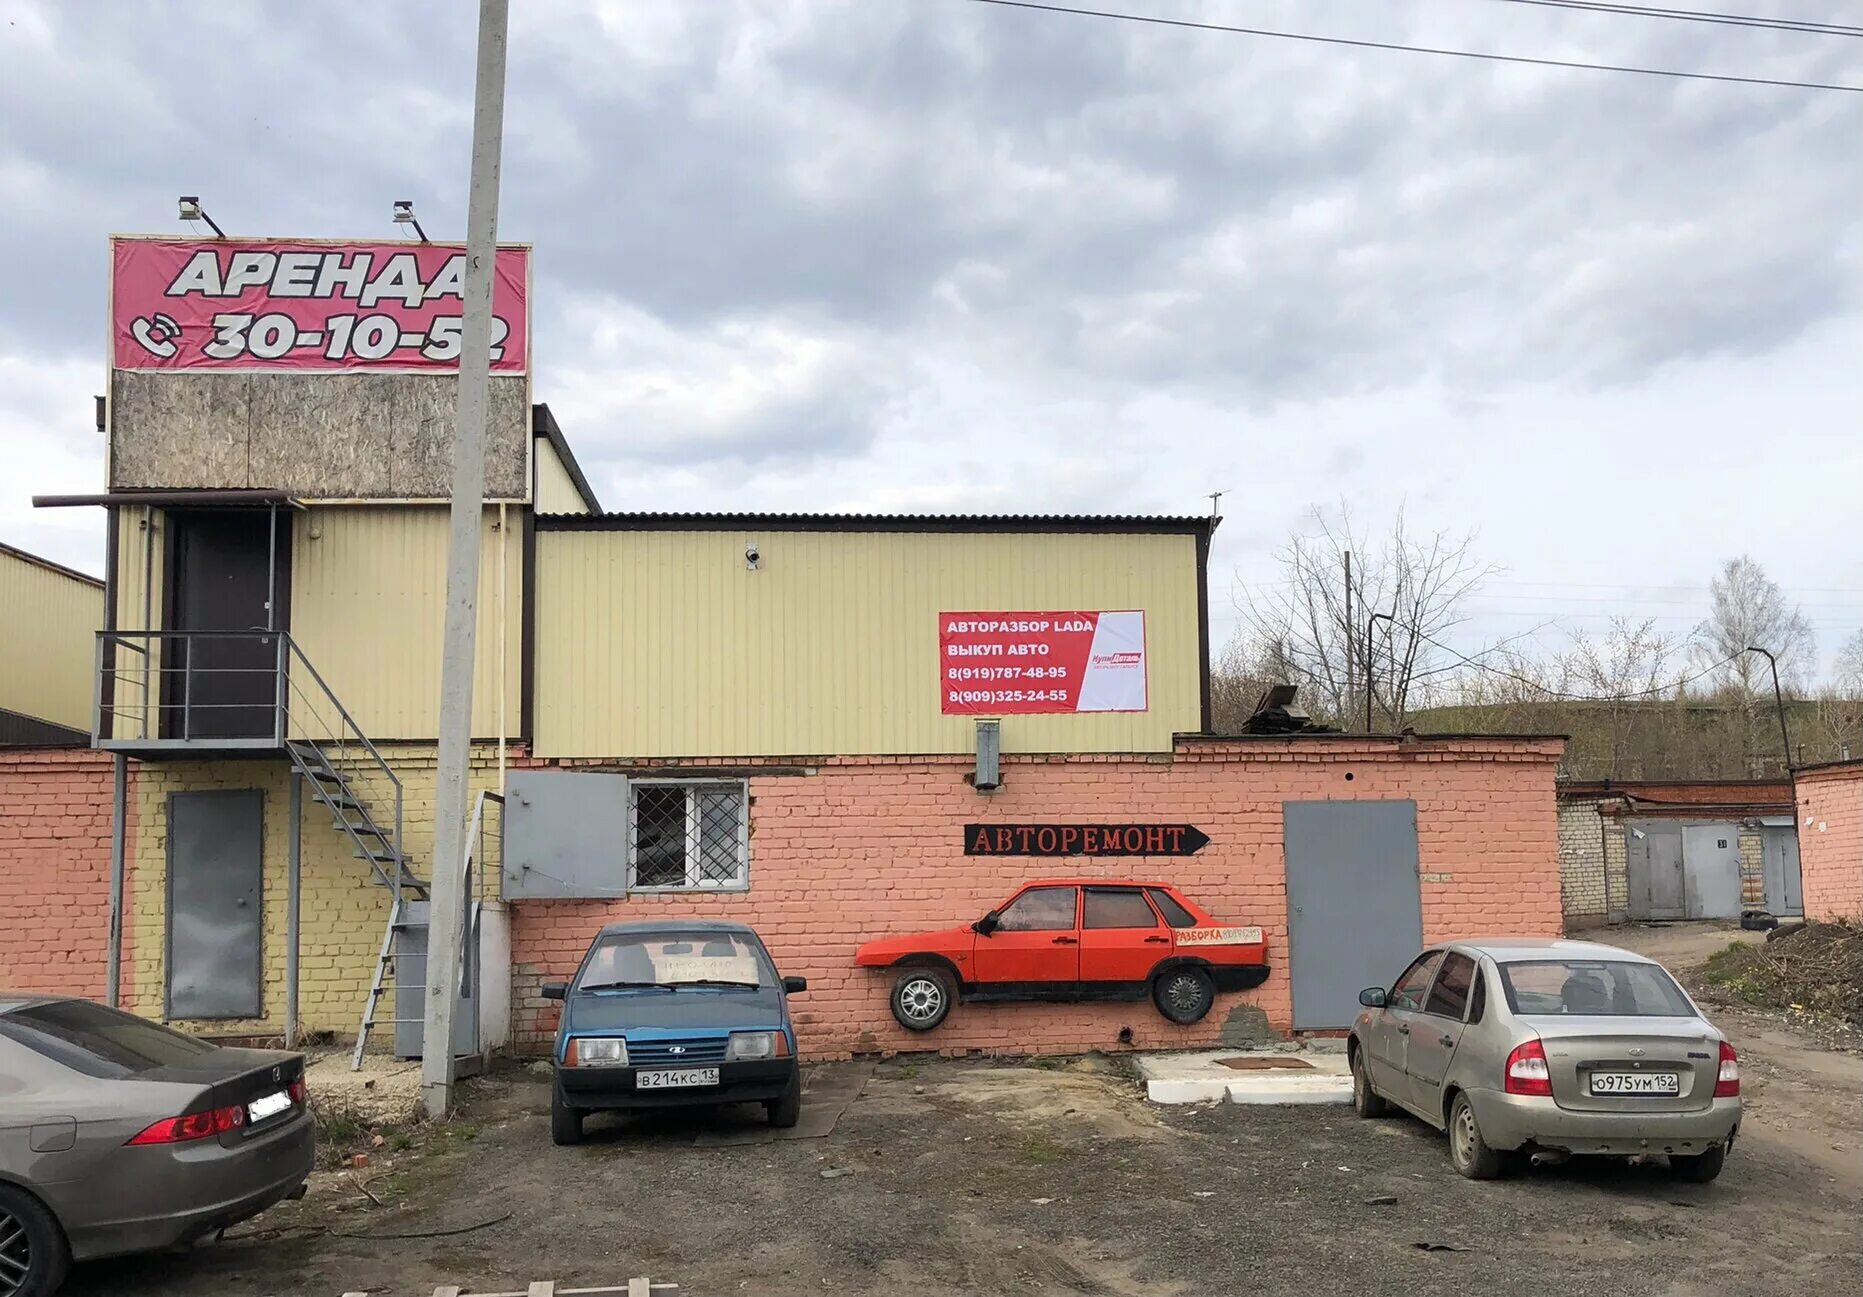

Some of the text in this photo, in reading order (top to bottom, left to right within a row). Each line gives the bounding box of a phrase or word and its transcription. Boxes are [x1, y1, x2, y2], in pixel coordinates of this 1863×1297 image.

[164, 250, 468, 308] АРЕНДА
[947, 620, 1094, 633] АВТОРАЗБОР LADA
[948, 644, 1049, 656] ВЫКУП АВТО
[948, 667, 1067, 681] 8(919)787-48-95
[949, 690, 1067, 704] 8(909)325-24-55
[972, 827, 1185, 851] АВТОРЕМОНТ
[1176, 929, 1222, 942] РАЗБОРКА
